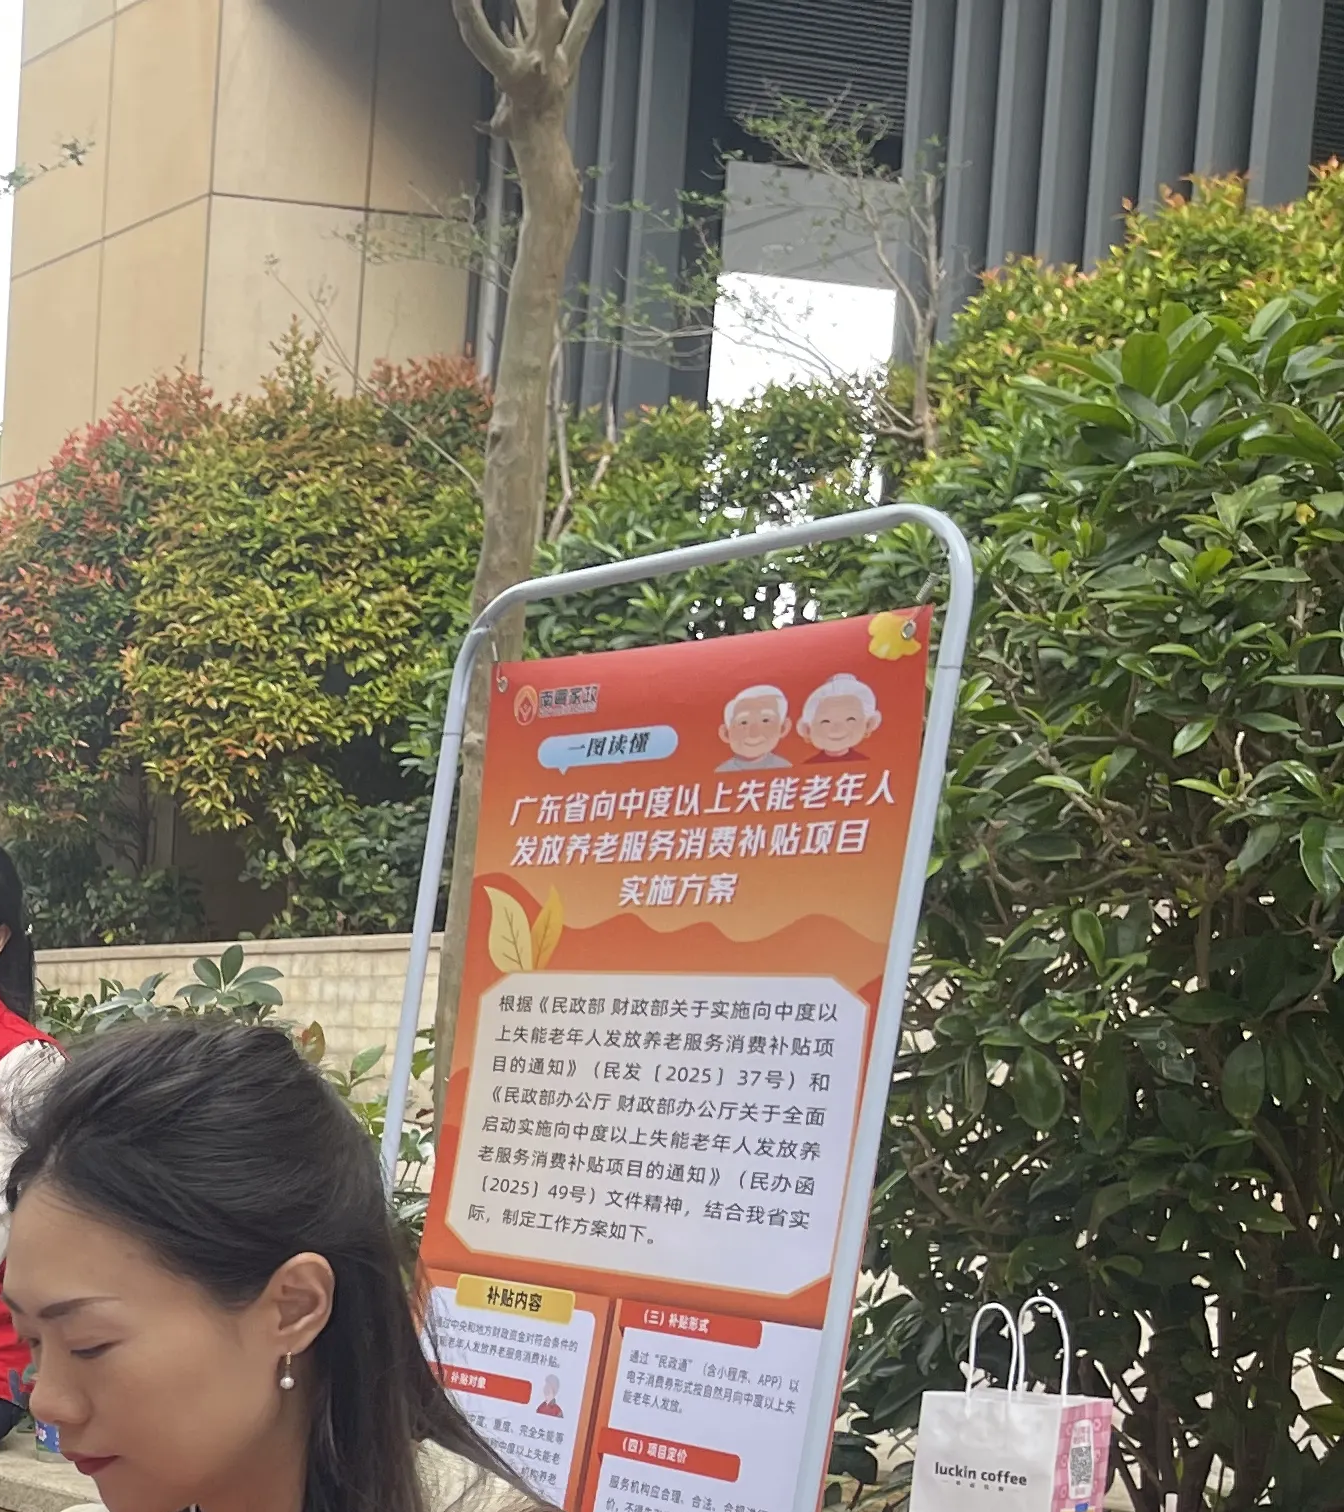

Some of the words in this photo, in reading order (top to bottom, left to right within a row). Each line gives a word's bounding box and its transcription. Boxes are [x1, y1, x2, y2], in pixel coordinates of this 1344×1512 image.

[567, 732, 651, 758] 一图读懂
[510, 769, 895, 827] 广东省向中度以上失能老年人
[510, 819, 870, 868] 发放养老服务消费补贴项目
[618, 872, 739, 908] 实施方案
[498, 995, 606, 1016] 根据《民政部
[610, 997, 838, 1022] 财政部关于实施向中度以
[495, 1024, 835, 1058] 上失能老年人发放养老服务消费补贴项
[492, 1085, 612, 1111] 《民政部办公厅
[616, 1094, 827, 1127] 财政部办公厅关于全面
[482, 1115, 821, 1161] 启动实施向中度以上失能老年人发放养
[486, 1285, 543, 1313] 补贴内容
[434, 1335, 560, 1368] 能老年人发放养老服务消费补贴。
[934, 1461, 977, 1480] luckin
[980, 1470, 1027, 1486] coffee
